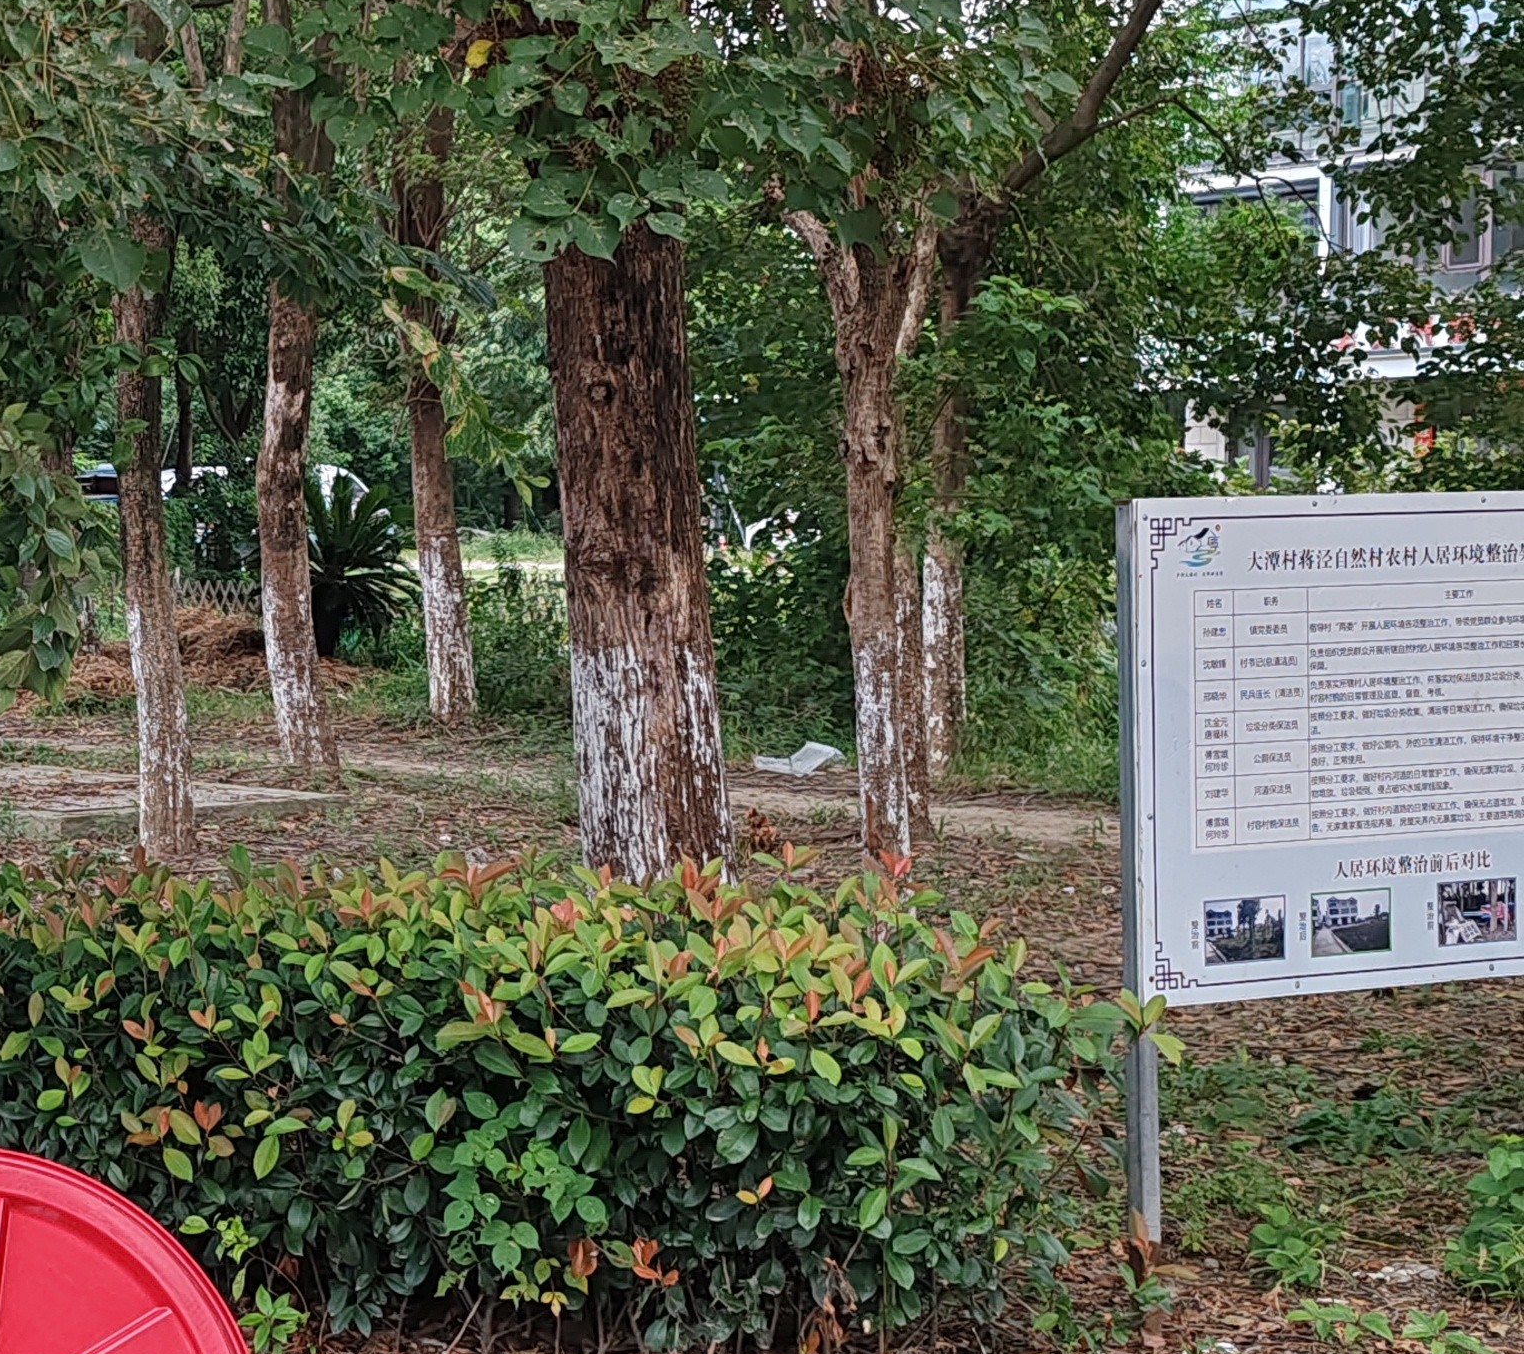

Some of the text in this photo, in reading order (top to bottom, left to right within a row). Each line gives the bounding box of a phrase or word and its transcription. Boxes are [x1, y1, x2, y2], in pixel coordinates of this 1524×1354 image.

[1444, 588, 1474, 599] 主要工作
[1205, 599, 1222, 609] 姓名
[1334, 850, 1491, 879] 人居环境整治前后对比
